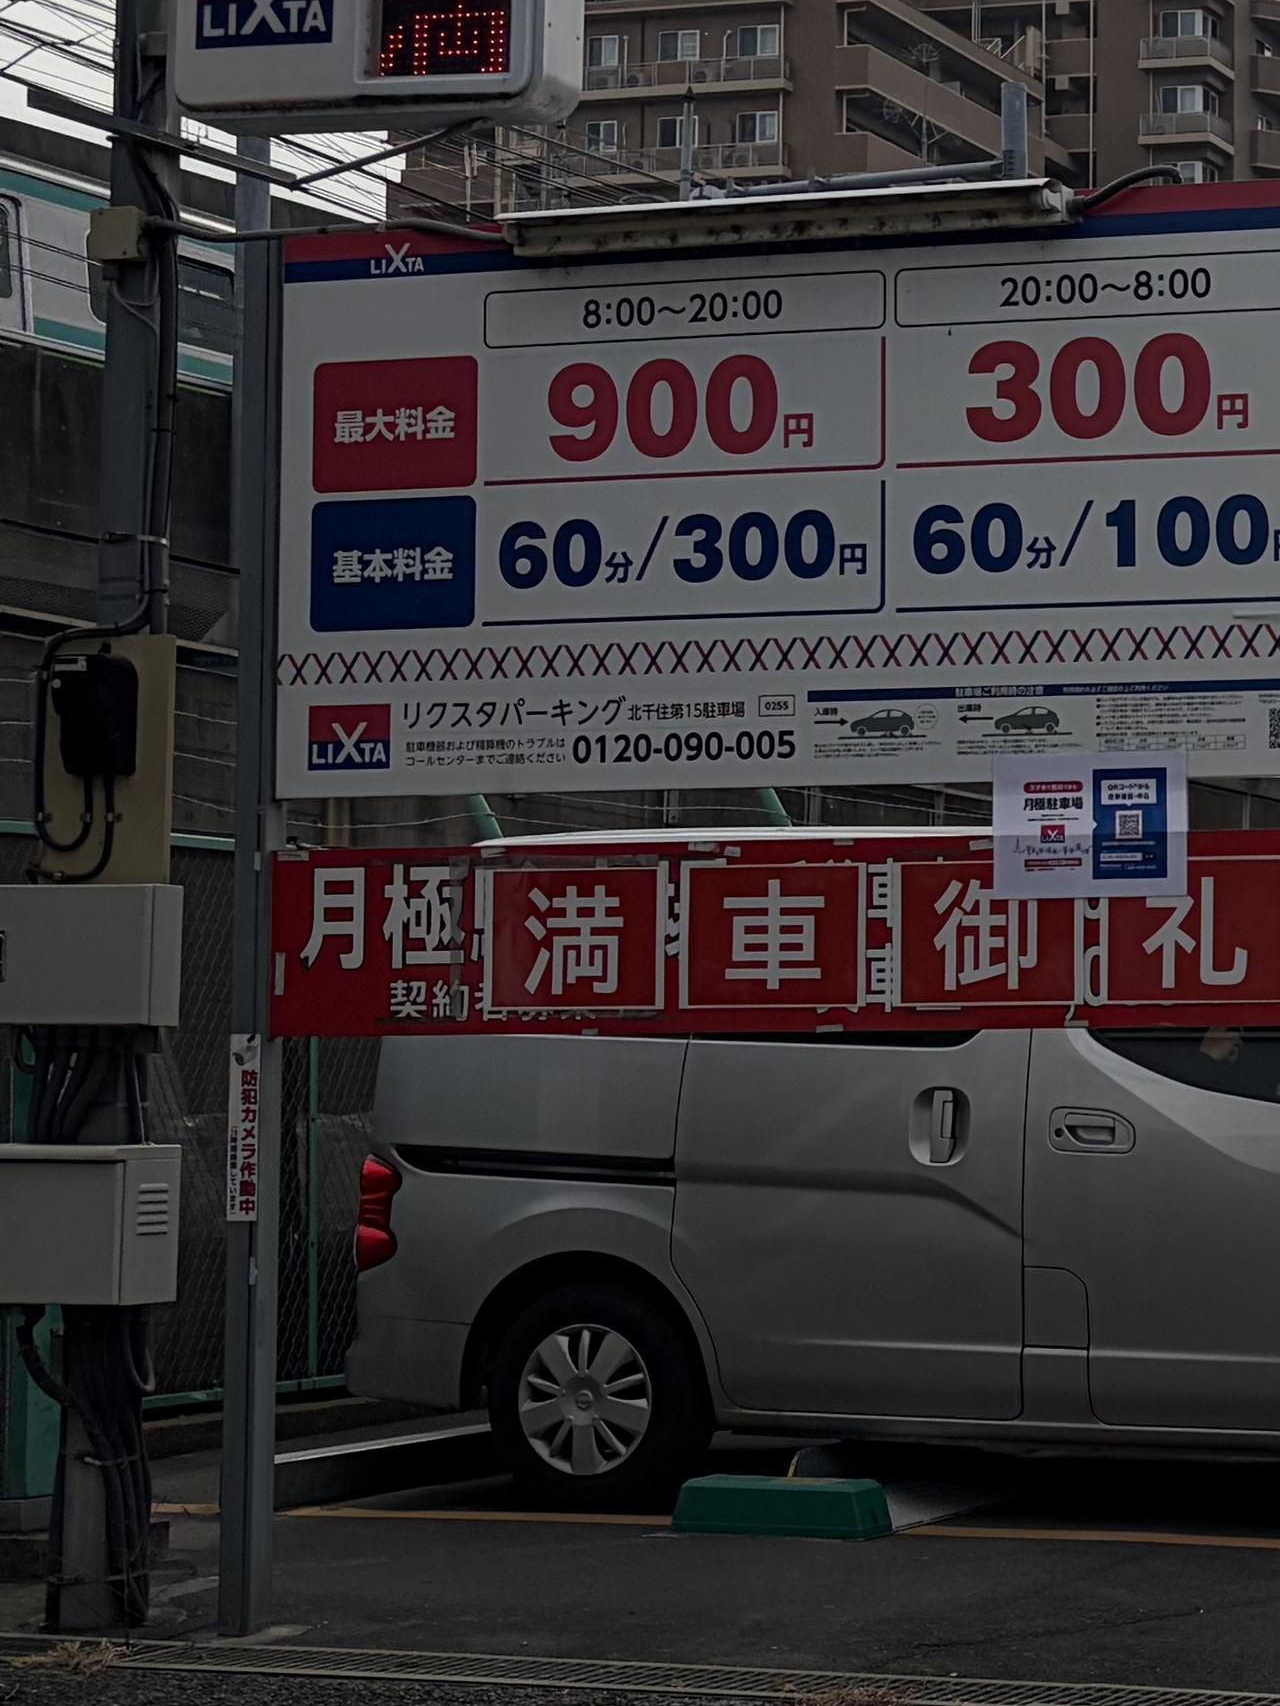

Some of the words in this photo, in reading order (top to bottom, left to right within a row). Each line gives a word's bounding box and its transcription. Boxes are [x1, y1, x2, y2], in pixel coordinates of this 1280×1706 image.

[370, 243, 424, 275] LIXTA
[334, 406, 456, 444] 最大料金
[547, 354, 815, 462] 900円
[966, 332, 1250, 443] 300円
[332, 547, 454, 583] 基本料金
[403, 696, 627, 729] リクスタパーキング
[627, 701, 746, 722] 北千住第15駐車場
[311, 722, 387, 766] LIXTA
[572, 730, 797, 766] 0120-090-005
[239, 1069, 259, 1216] 防犯カメラ作動中
